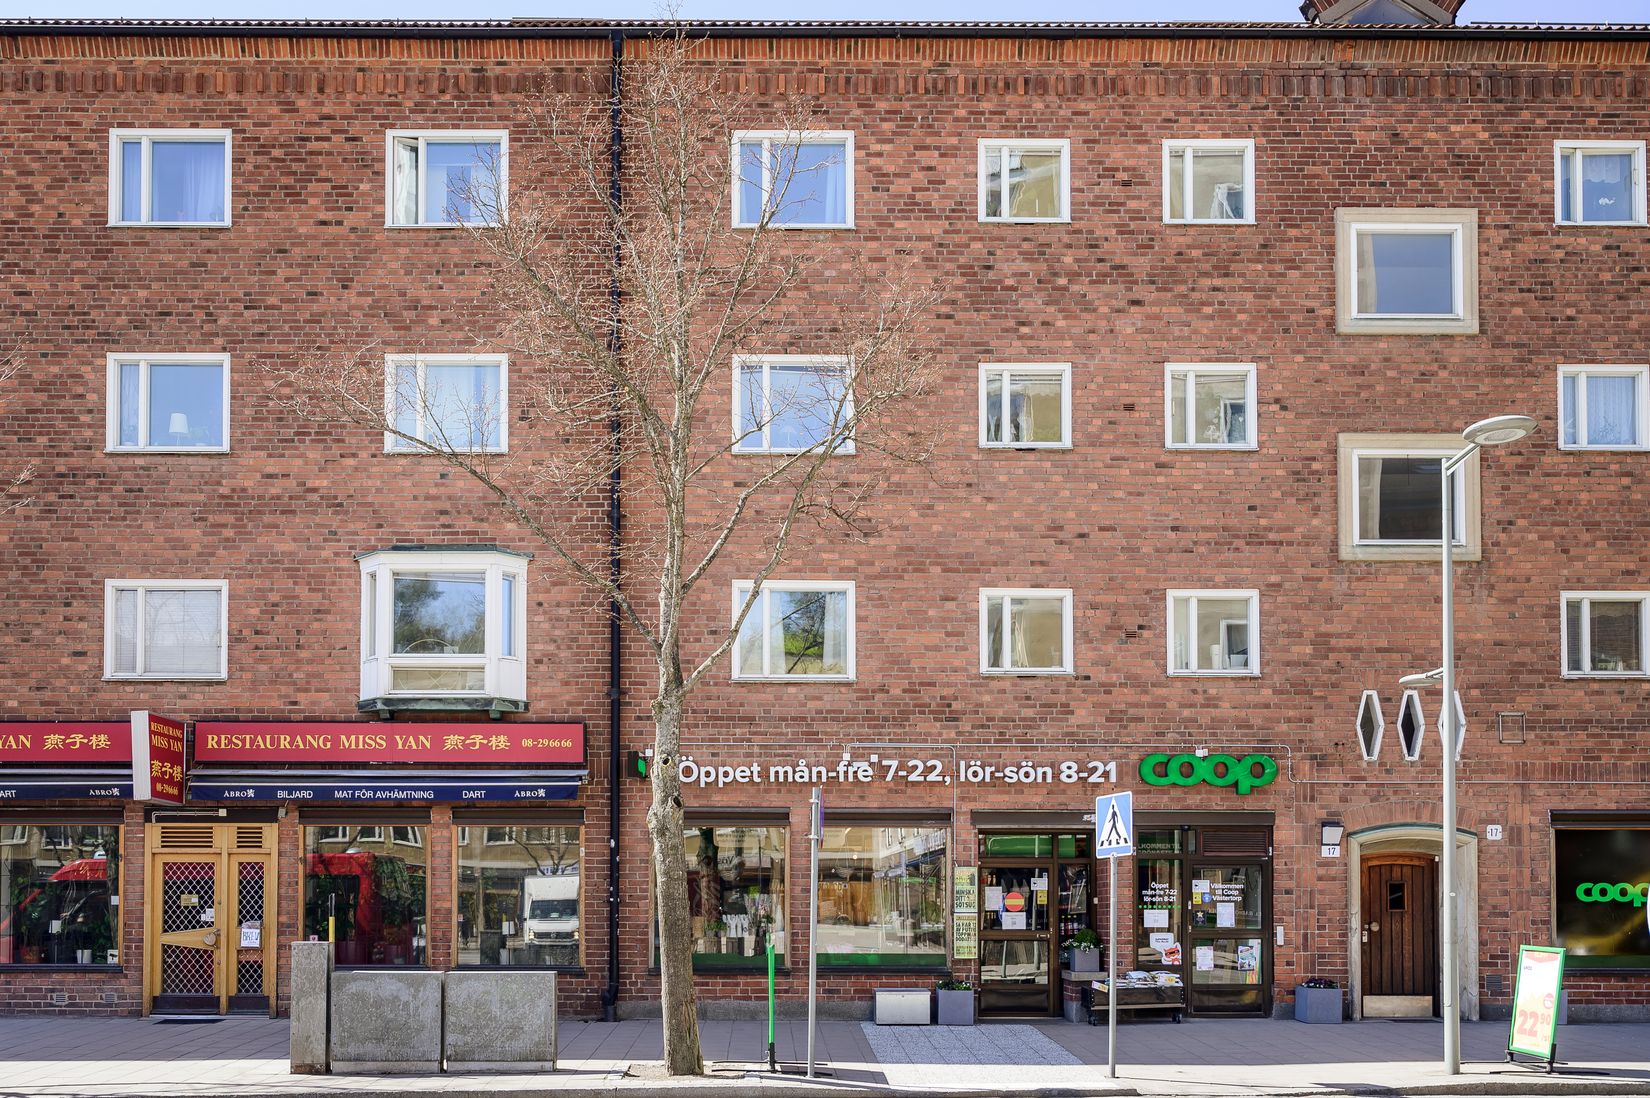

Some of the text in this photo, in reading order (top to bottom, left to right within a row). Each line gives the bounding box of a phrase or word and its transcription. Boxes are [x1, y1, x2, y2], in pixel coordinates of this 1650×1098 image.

[150, 722, 183, 739] RESTAURANG
[43, 734, 111, 750] 燕子楼
[151, 734, 183, 753] MISS YAN
[206, 734, 332, 750] RESTAURANG
[339, 734, 387, 750] MISS
[394, 735, 432, 750] YAN
[443, 734, 511, 751] 燕子楼
[151, 760, 183, 782] 燕子楼
[679, 755, 1117, 788] Öppet mån-fre 7-22, lör-sön 8-21
[1138, 753, 1279, 796] coop
[277, 790, 313, 799] BILJARD
[334, 788, 434, 799] MAT FÖR AVHÄMTNING
[462, 790, 486, 799] DART
[1490, 828, 1499, 837] 17
[1327, 847, 1336, 855] 17
[1150, 881, 1169, 889] Öppet
[1575, 882, 1648, 907] coop
[1517, 1009, 1551, 1038] 22 90
